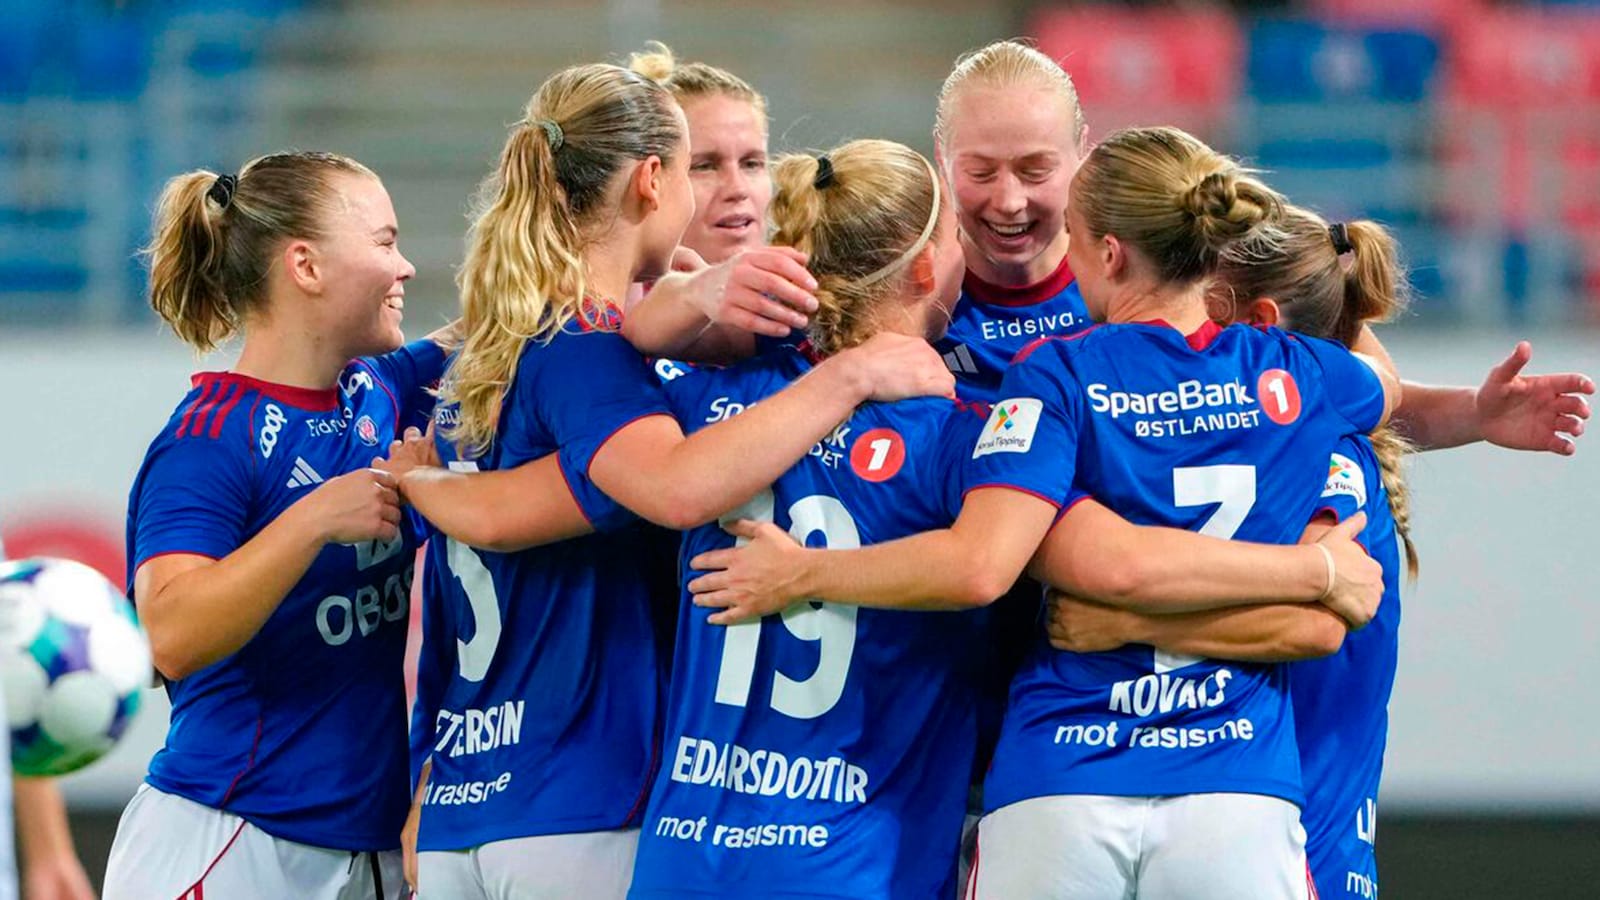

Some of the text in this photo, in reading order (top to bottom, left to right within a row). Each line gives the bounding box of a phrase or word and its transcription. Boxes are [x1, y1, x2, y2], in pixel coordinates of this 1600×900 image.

[1086, 377, 1289, 418] SpareBank 1
[1134, 409, 1260, 437] ØSTLANDET
[714, 485, 861, 720] 19
[1108, 668, 1233, 717] KOVACS
[1054, 718, 1254, 749] mot rasisme
[656, 816, 829, 848] mot rasisme
